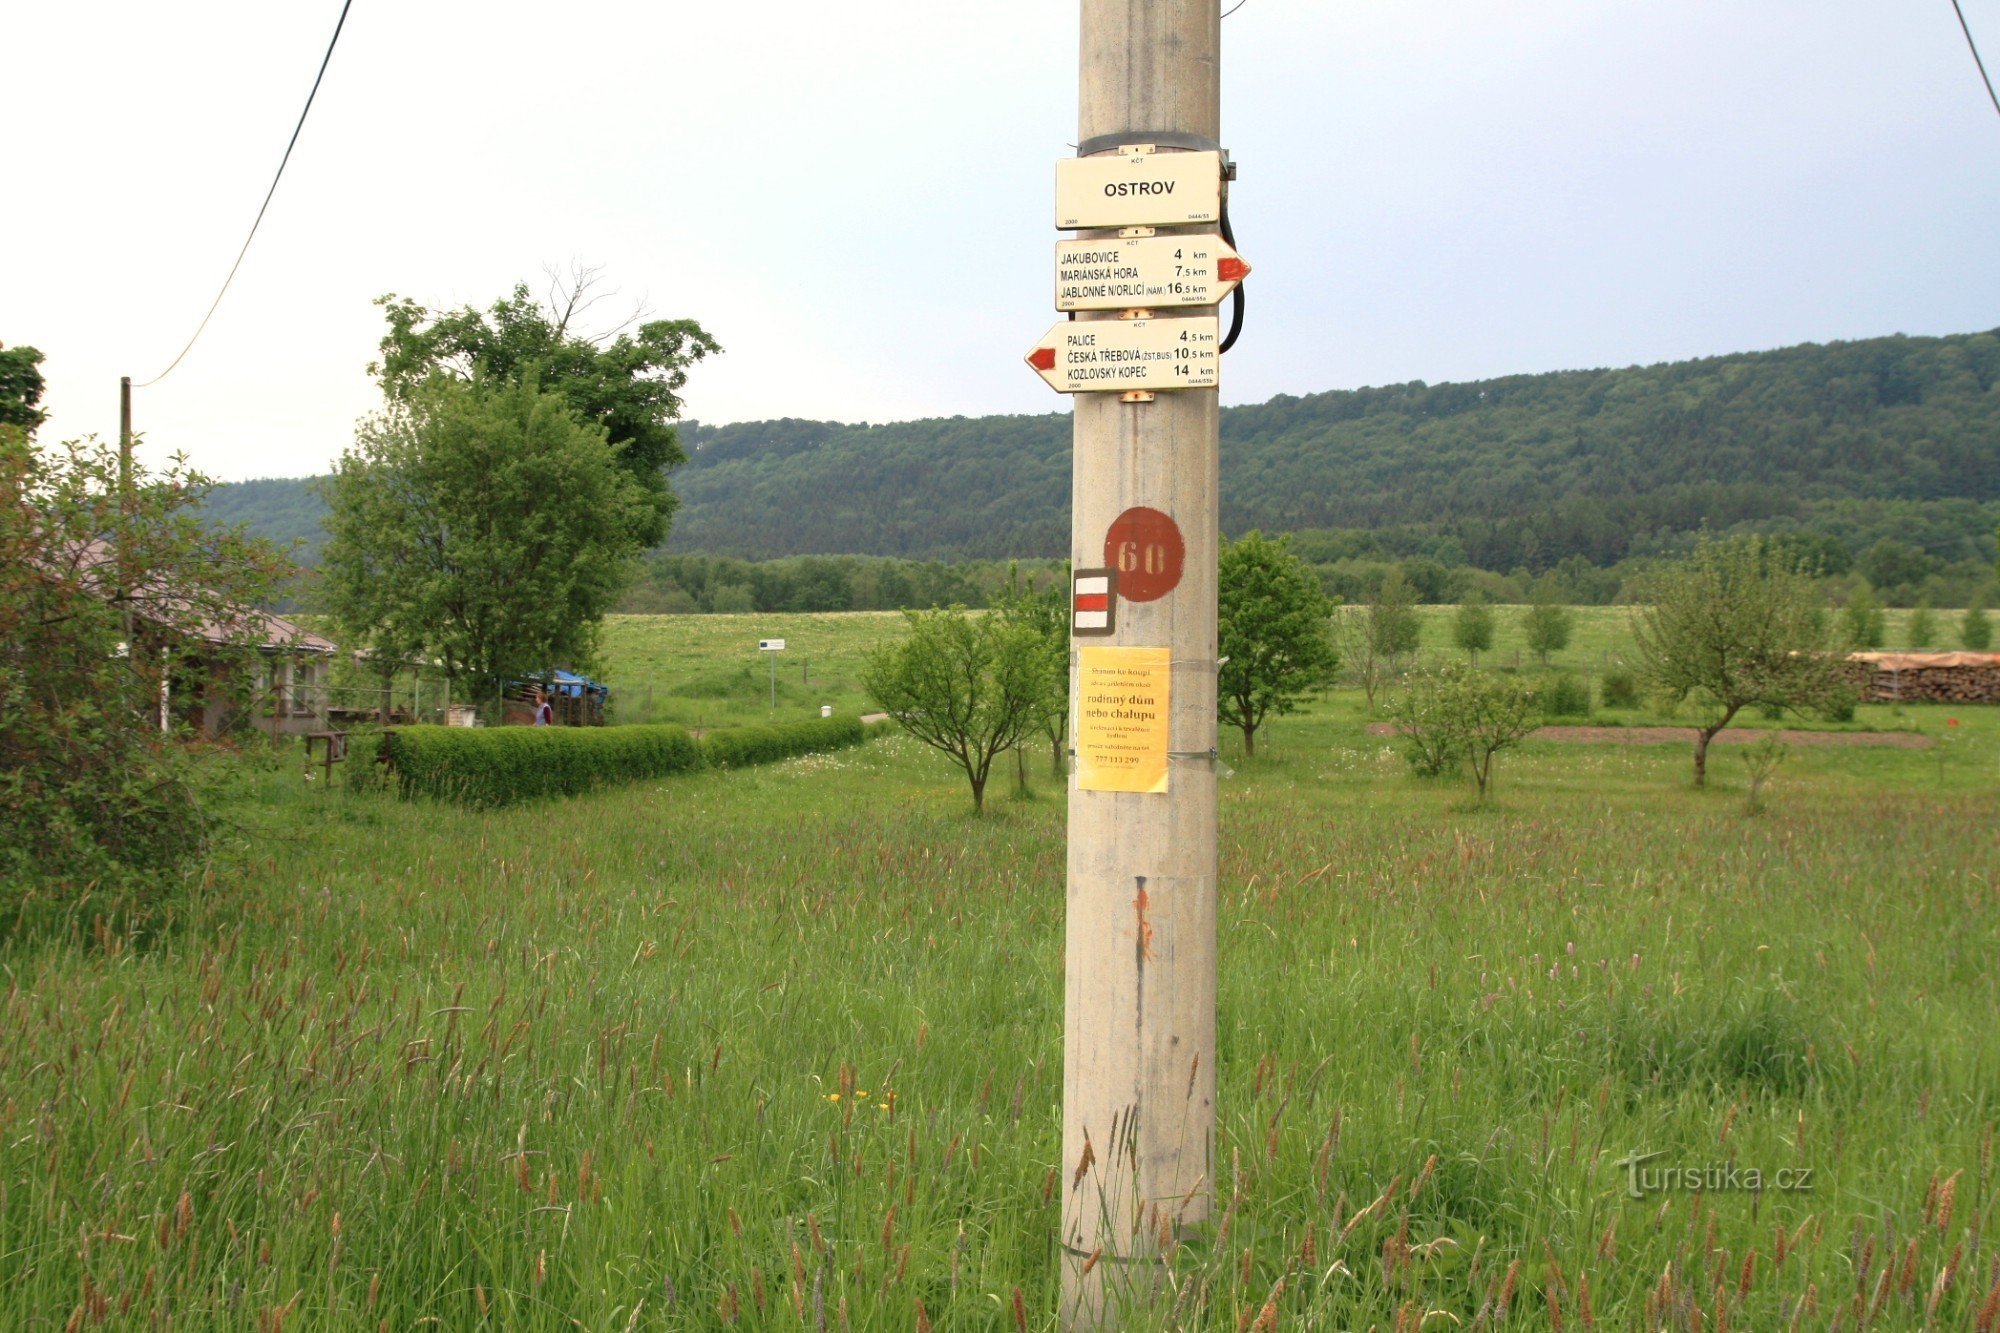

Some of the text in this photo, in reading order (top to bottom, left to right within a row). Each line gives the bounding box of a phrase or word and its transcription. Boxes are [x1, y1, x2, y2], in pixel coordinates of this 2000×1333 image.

[1104, 181, 1175, 197] OSTROV
[1061, 251, 1119, 264] JAKUBOVICE
[1174, 249, 1182, 260] 4
[1060, 266, 1111, 281] MARIÁNSKÁ
[1113, 267, 1138, 279] HORA
[1175, 265, 1191, 277] 7,5
[1061, 283, 1106, 298] JABLONNÉ
[1167, 282, 1191, 294] 16,5
[1067, 335, 1096, 346] PALICE
[1180, 330, 1197, 342] 4,5
[1067, 349, 1097, 364] ČESKÁ
[1099, 347, 1141, 362] TŘEBOVÁ
[1174, 348, 1197, 359] 10,5
[1067, 366, 1116, 380] KOZLOVSKÝ
[1118, 366, 1146, 378] KOPEC
[1174, 365, 1189, 376] 14
[1118, 541, 1164, 574] 60
[1087, 694, 1154, 706] rodinný dům
[1086, 708, 1155, 721] nebo chalupu
[1095, 755, 1108, 763] 777
[1124, 756, 1140, 764] 299
